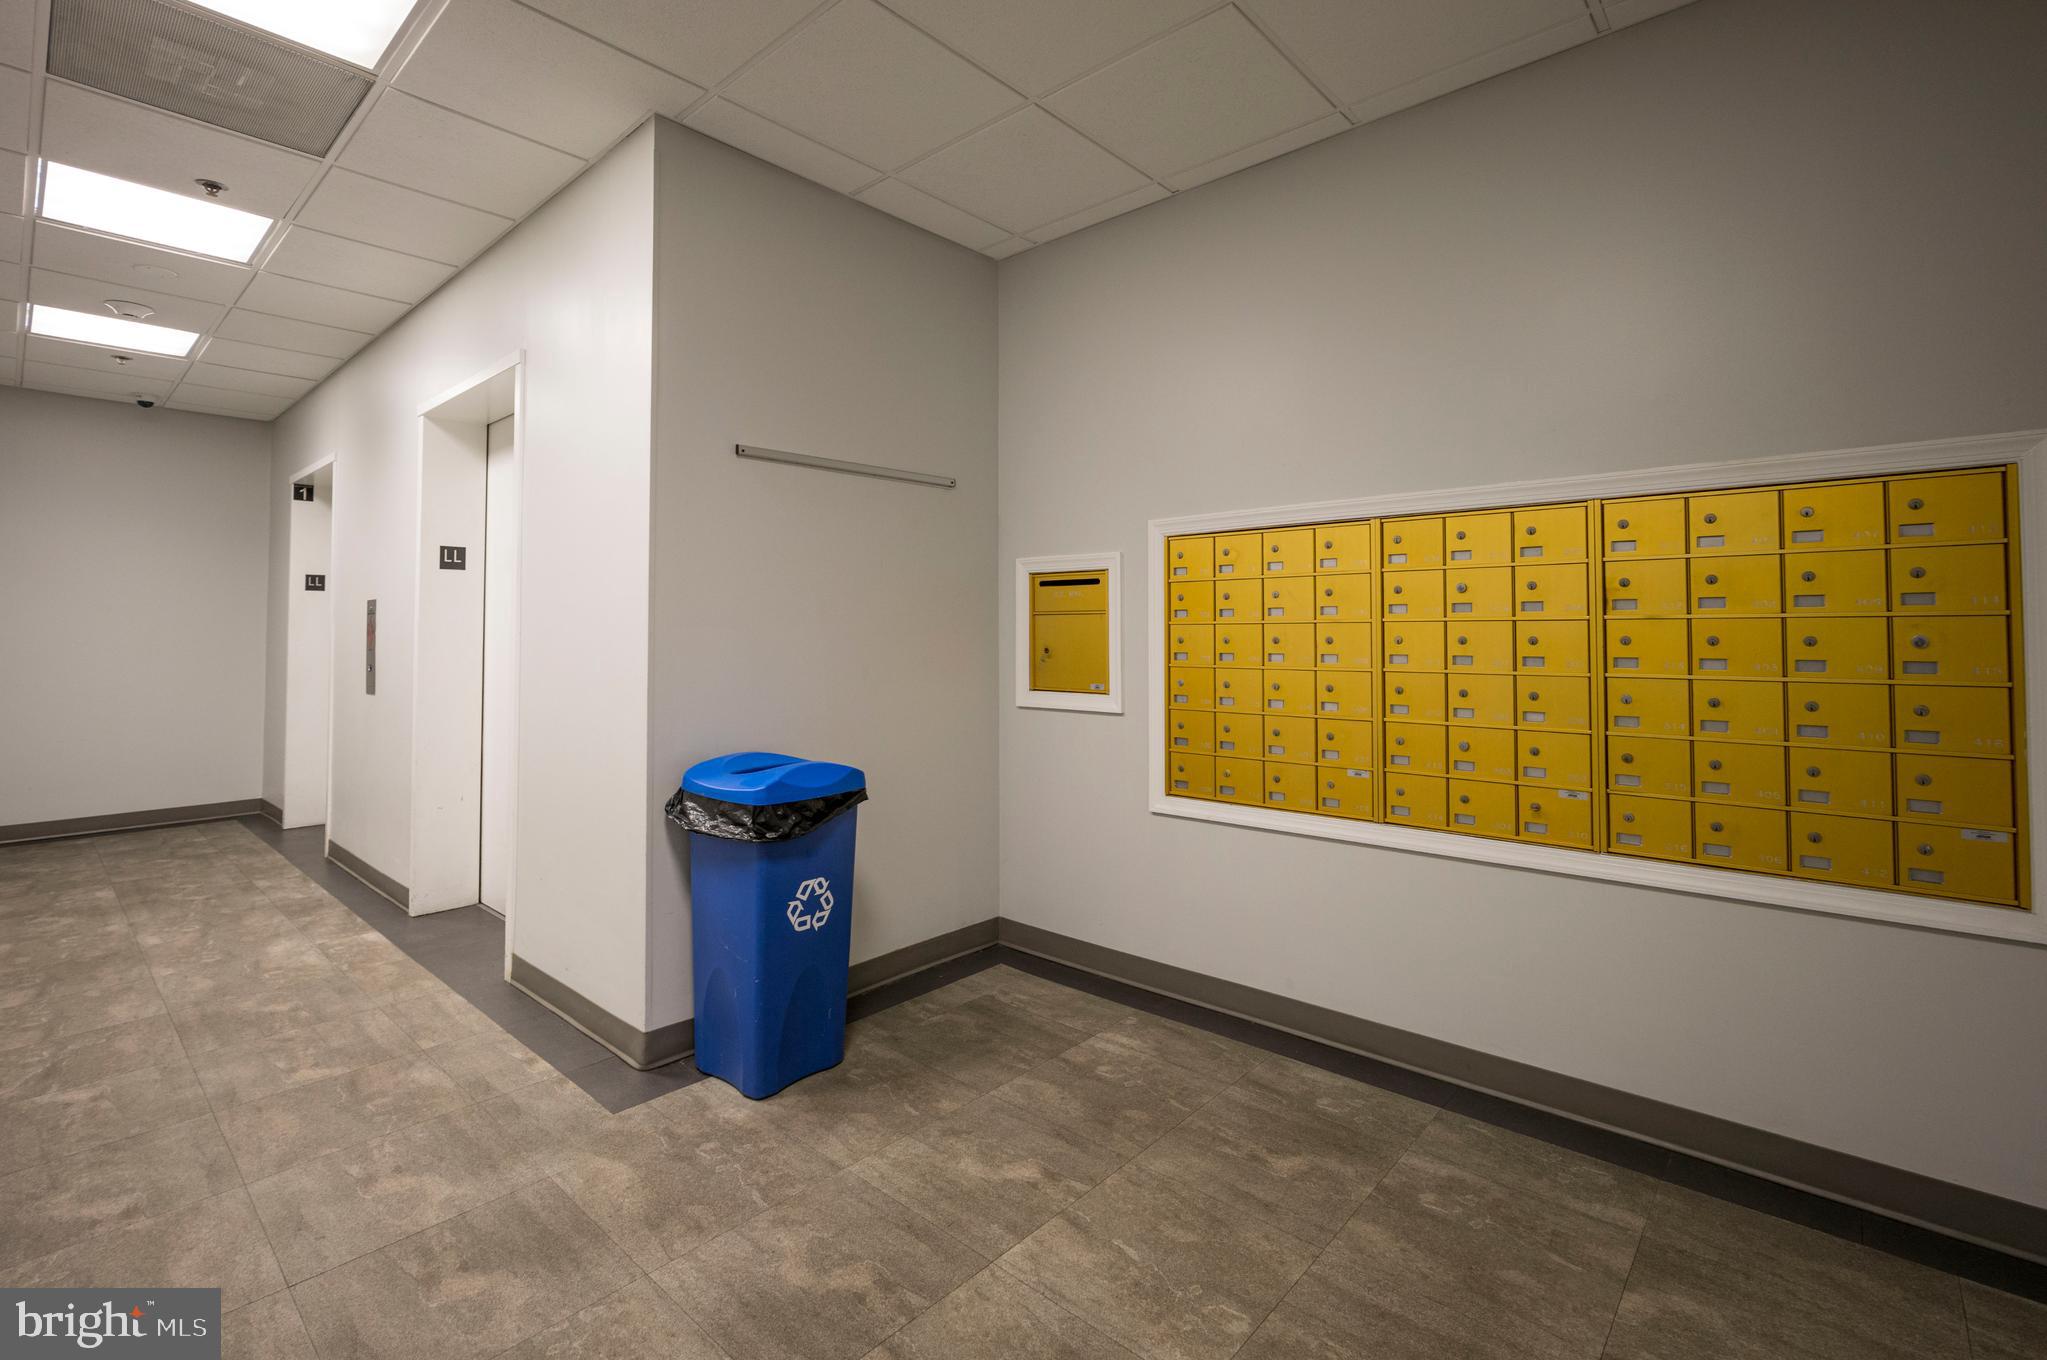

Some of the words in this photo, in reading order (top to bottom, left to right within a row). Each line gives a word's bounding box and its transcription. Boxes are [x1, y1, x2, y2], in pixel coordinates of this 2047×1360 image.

[300, 487, 307, 500] 1
[444, 549, 462, 562] LL
[308, 577, 322, 586] LL
